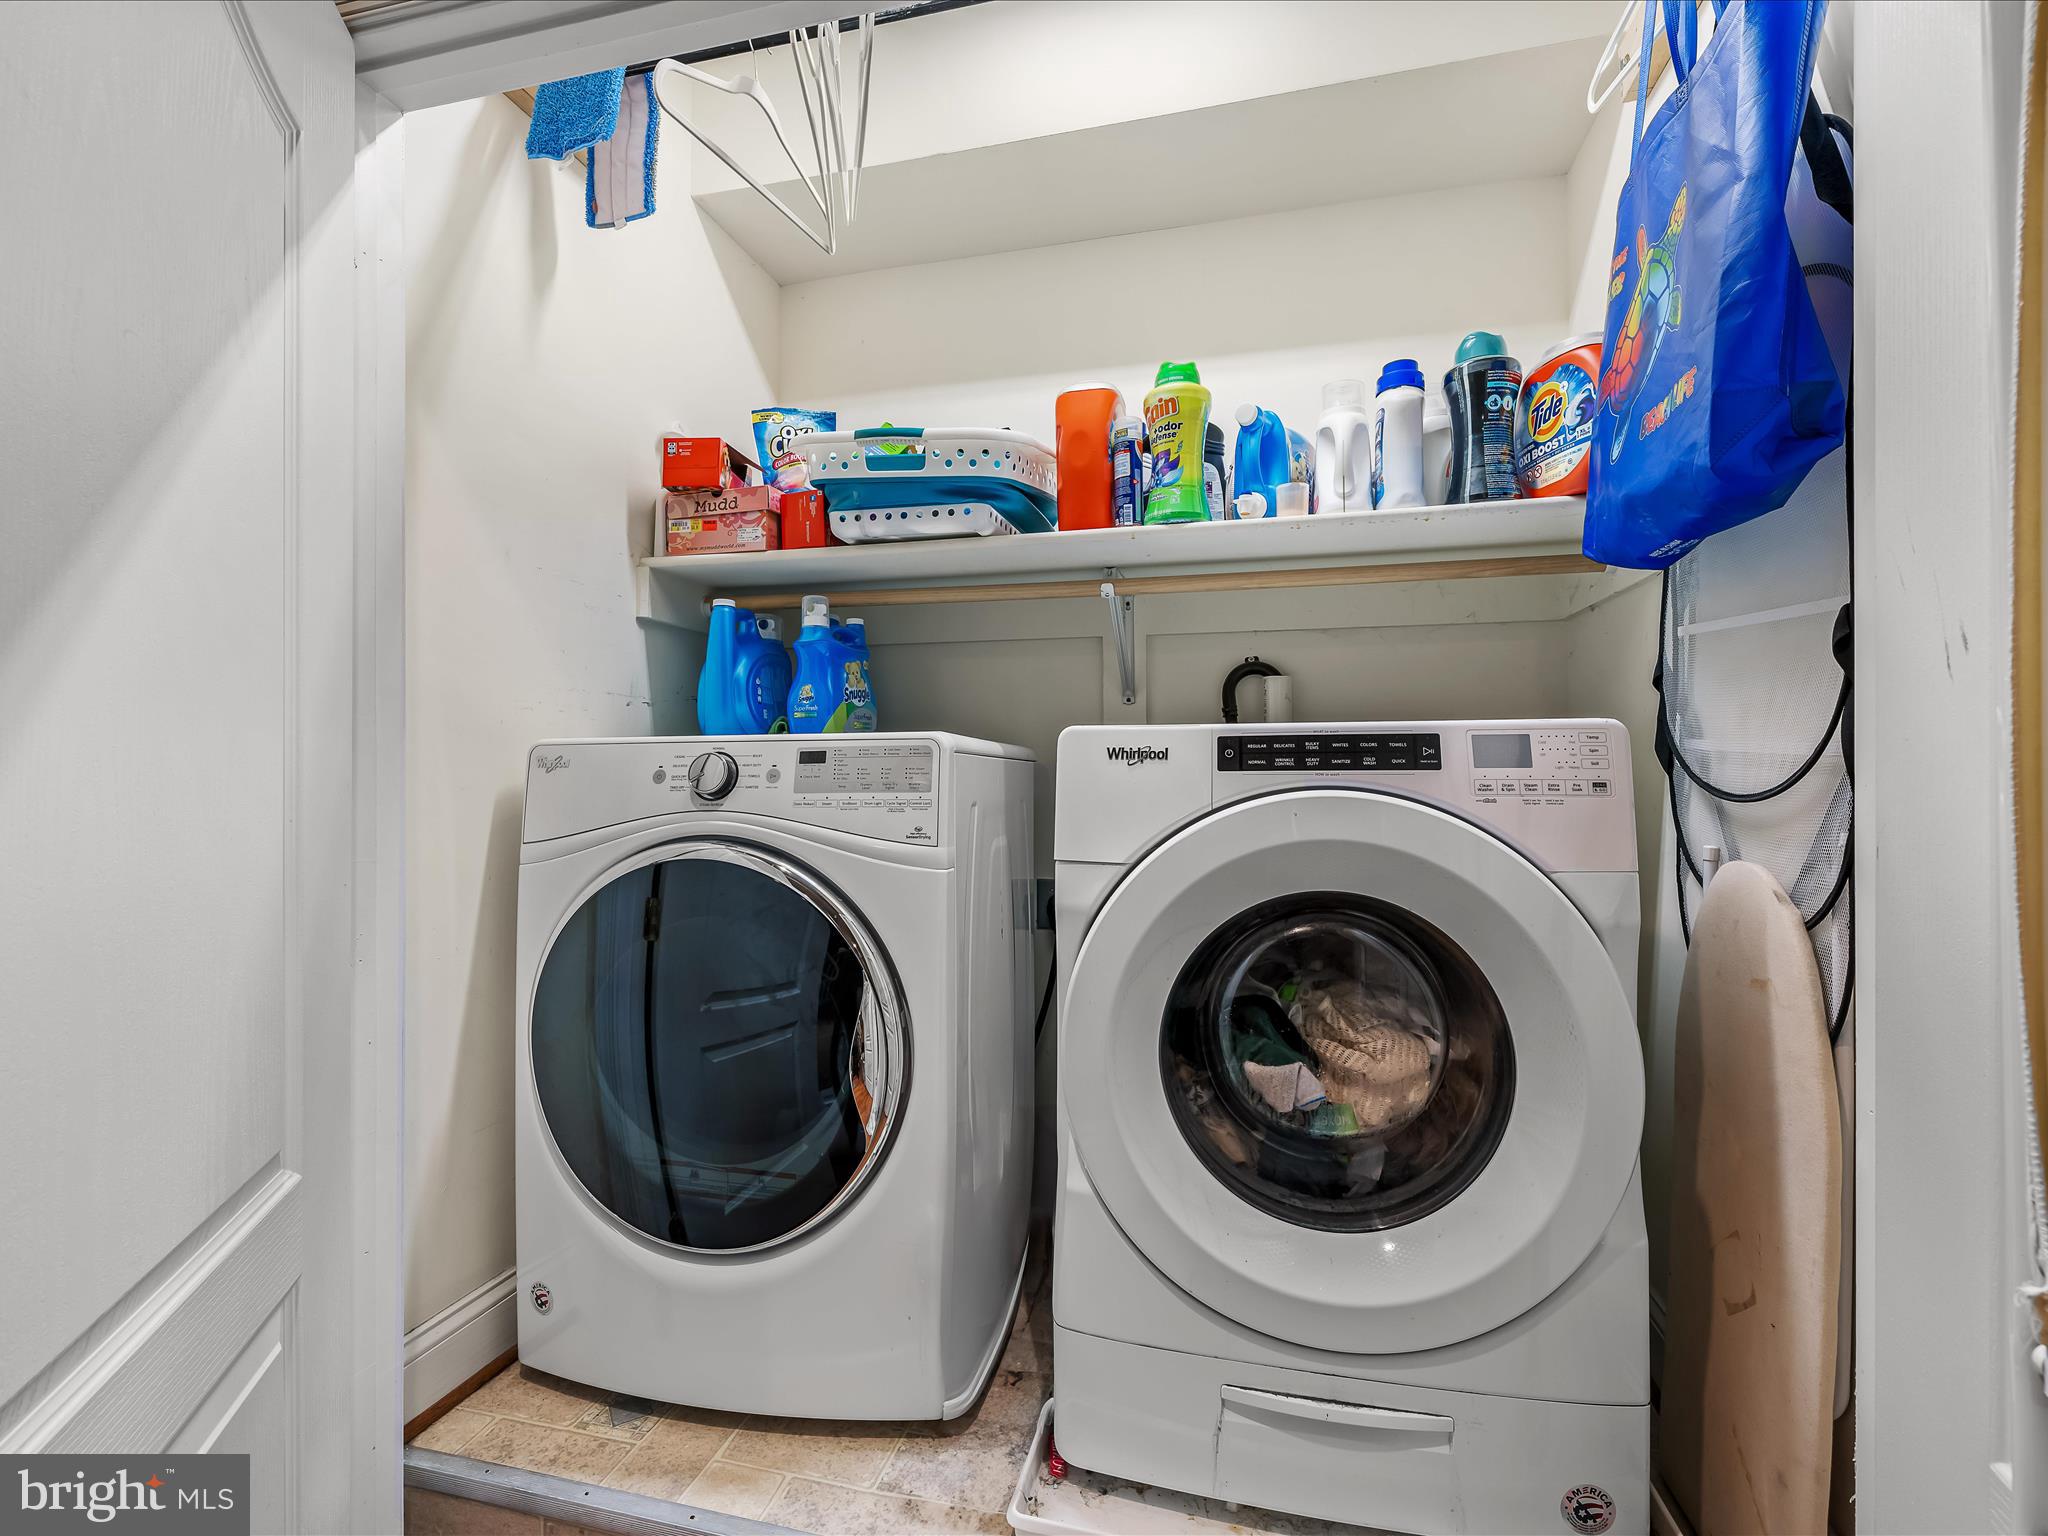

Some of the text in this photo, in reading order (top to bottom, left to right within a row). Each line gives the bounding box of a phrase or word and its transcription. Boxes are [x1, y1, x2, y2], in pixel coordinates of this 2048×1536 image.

[1531, 392, 1564, 437] Tide
[1518, 453, 1531, 468] OXI
[1531, 434, 1565, 458] BOOST
[694, 496, 739, 513] Mudd
[1106, 745, 1169, 766] Whirlpool
[1565, 1486, 1613, 1508] AMERICA
